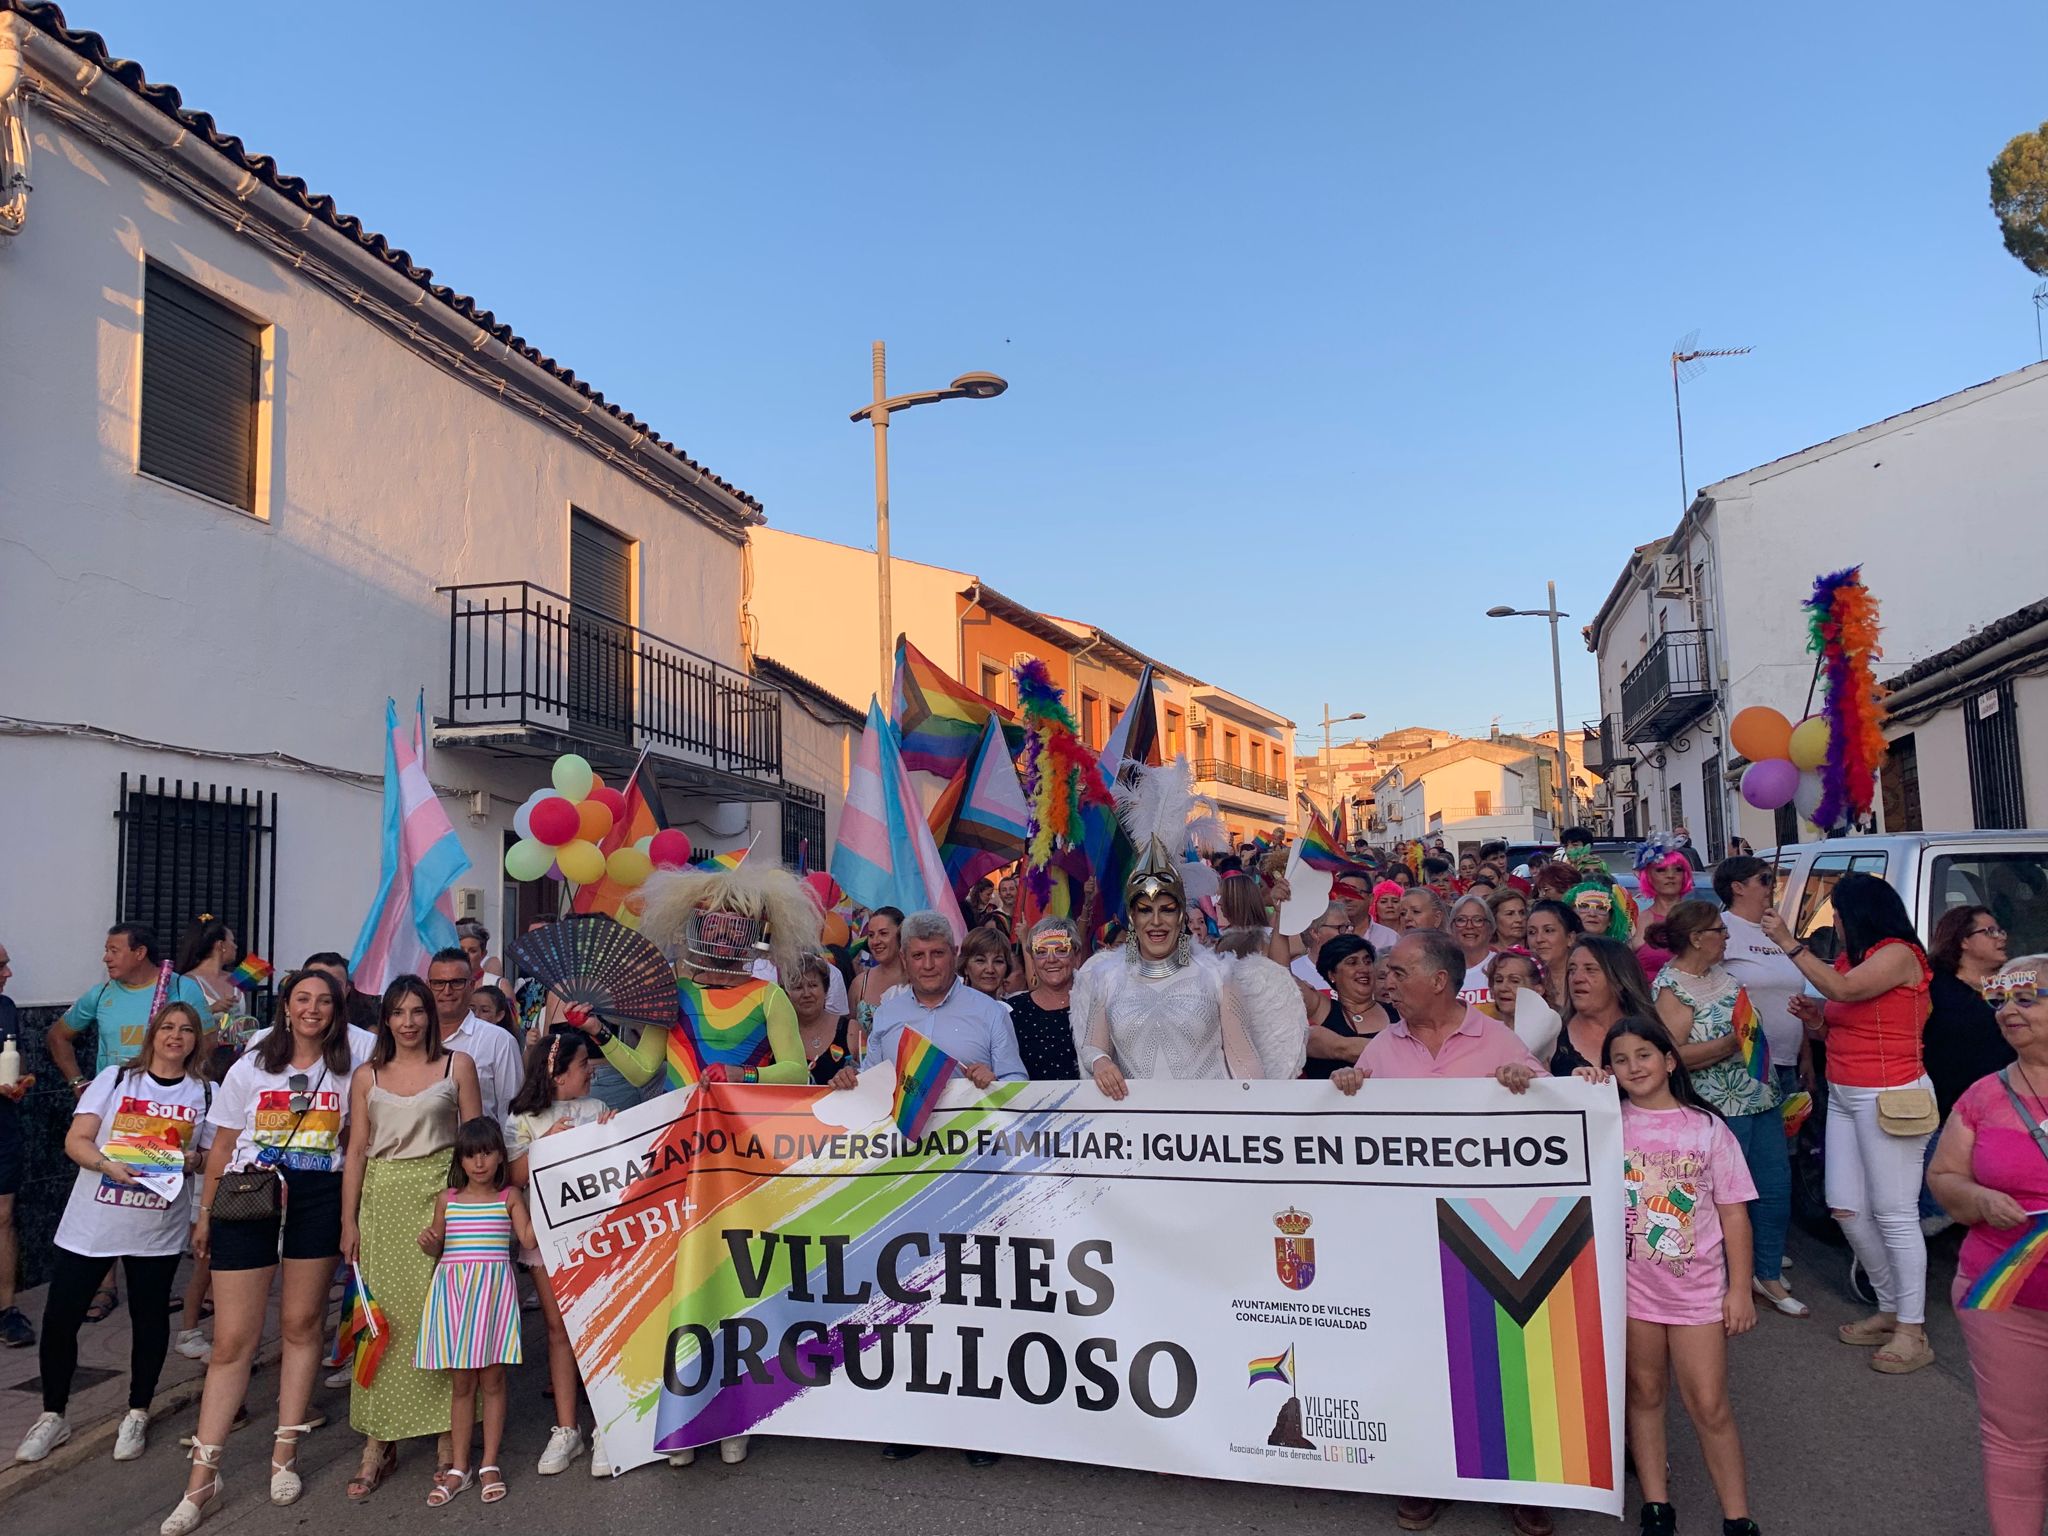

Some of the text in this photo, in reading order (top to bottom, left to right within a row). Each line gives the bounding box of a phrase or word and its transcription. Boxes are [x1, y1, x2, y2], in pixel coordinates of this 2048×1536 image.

[115, 1114, 146, 1130] LOS
[146, 1101, 196, 1121] SOLO
[257, 1112, 290, 1129] LOS
[730, 1132, 765, 1160] LA
[774, 1130, 969, 1160] DIVERSIDAD
[977, 1130, 1133, 1161] FAMILIAR:
[1143, 1133, 1283, 1165] IGUALES
[1294, 1136, 1343, 1165] EN
[1355, 1135, 1569, 1168] DERECHOS
[96, 1185, 168, 1209] LA BOCA
[555, 1196, 698, 1271] LGTBI+
[721, 1229, 1115, 1317] VILCHES
[1231, 1299, 1371, 1317] AYUNTAMIENTO DE VILCHES
[1236, 1312, 1367, 1330] CONCEJALÍA DE IGUALDAD
[663, 1317, 1198, 1419] ORGULLOSO
[1304, 1395, 1359, 1420] VILCHES
[1305, 1416, 1387, 1442] ORGULLOSO
[1229, 1443, 1376, 1464] Asociación por los derechos LGTBIQ+
